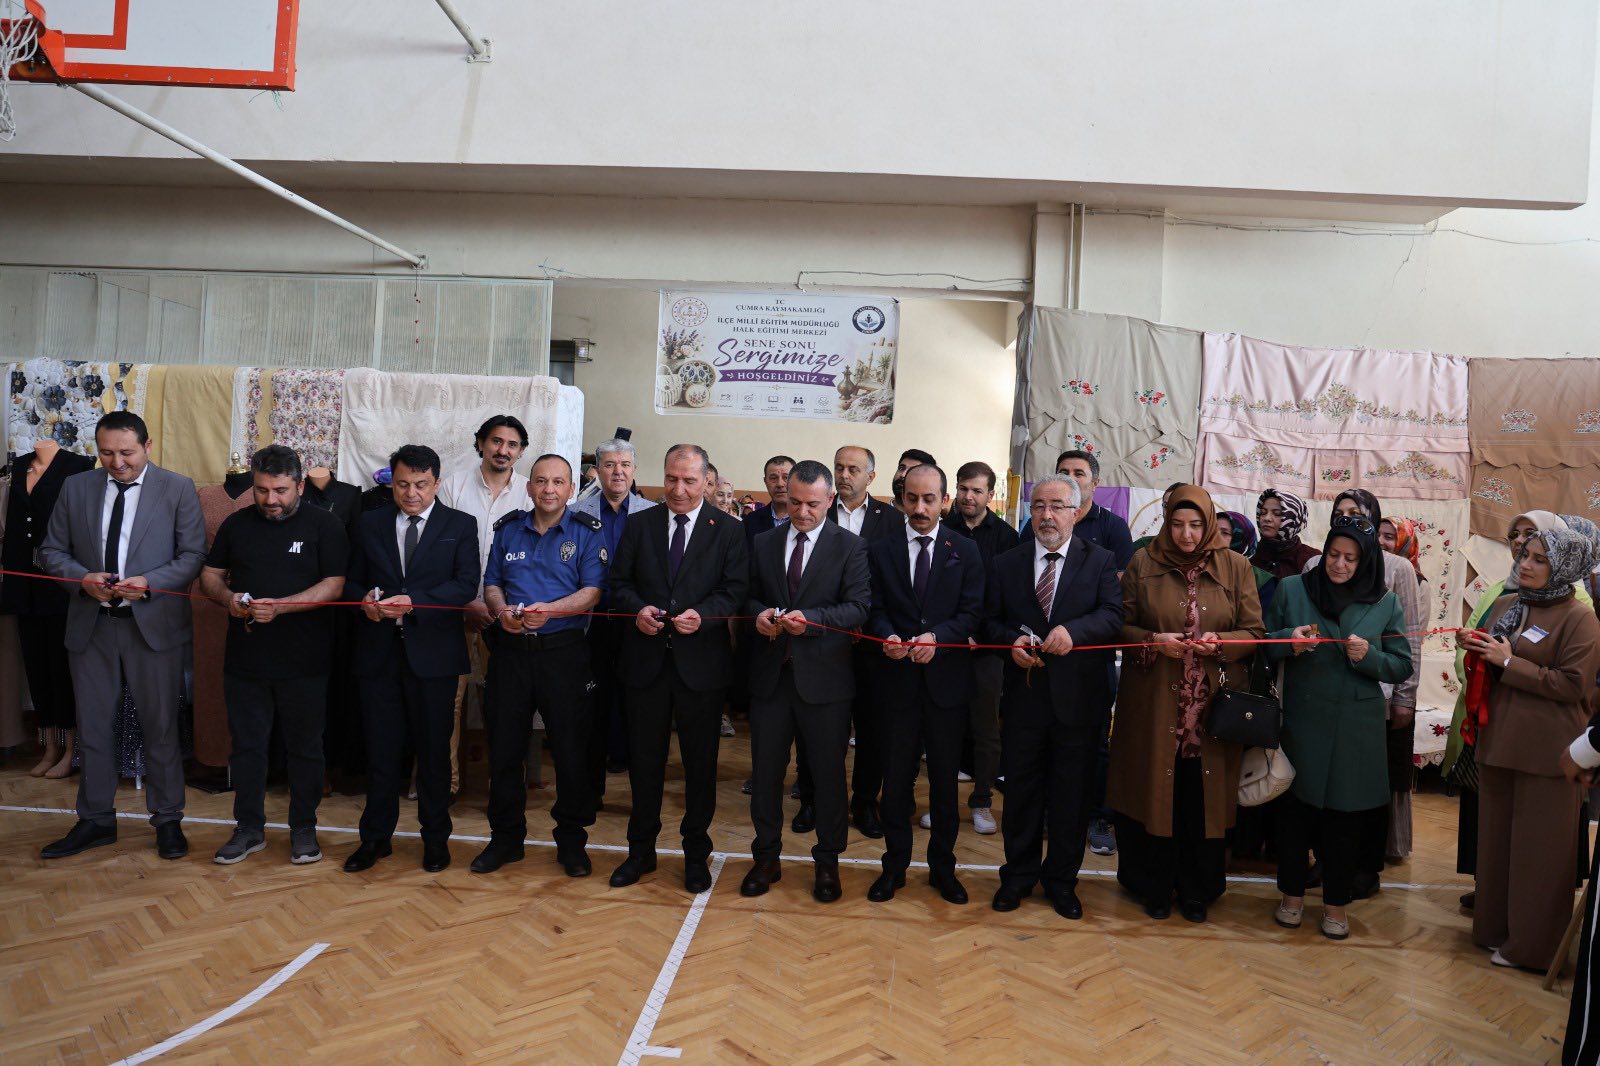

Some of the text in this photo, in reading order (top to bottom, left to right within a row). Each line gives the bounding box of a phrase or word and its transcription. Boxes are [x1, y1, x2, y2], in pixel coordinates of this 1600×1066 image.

[717, 317, 734, 325] İLÇE
[790, 319, 840, 328] MÜDÜRLÜĞÜ
[757, 326, 789, 335] EĞİTİMİ
[791, 328, 827, 336] MERKEZİ
[744, 339, 816, 350] SENE SONU
[713, 338, 844, 374] Sergimize
[737, 372, 818, 383] HOŞGELDİNİZ
